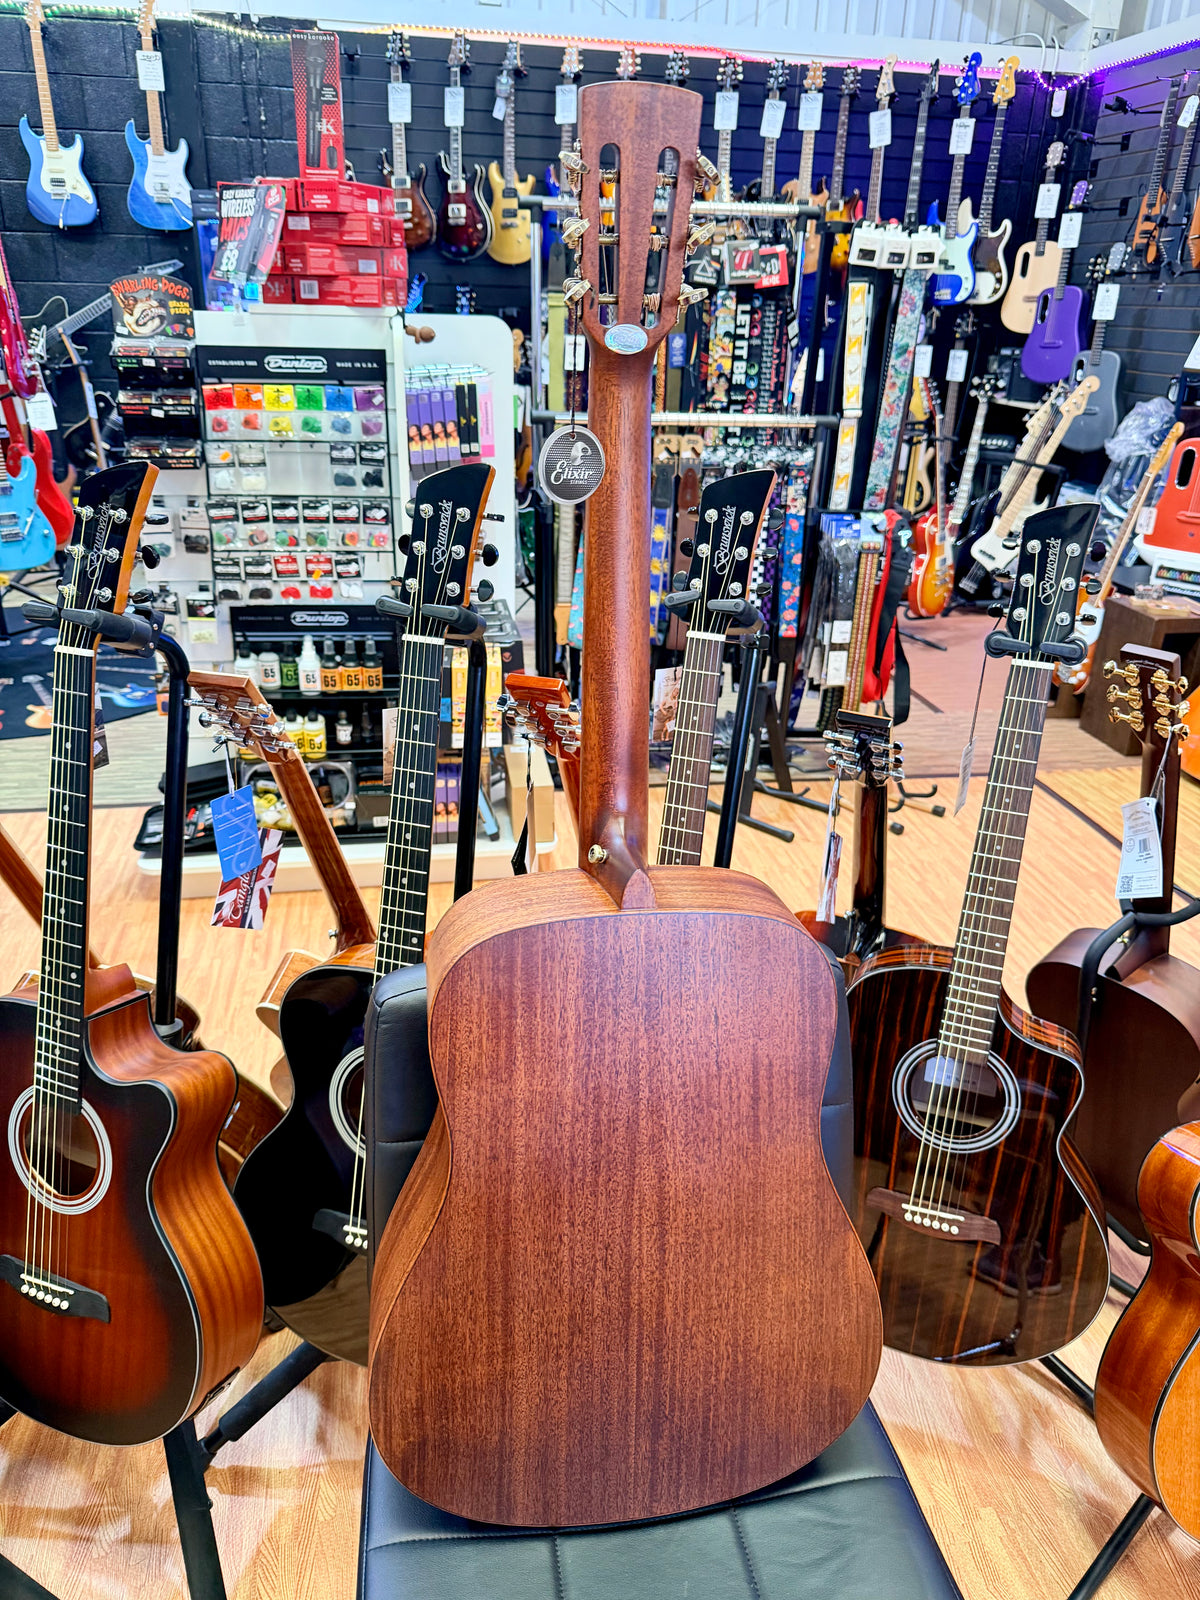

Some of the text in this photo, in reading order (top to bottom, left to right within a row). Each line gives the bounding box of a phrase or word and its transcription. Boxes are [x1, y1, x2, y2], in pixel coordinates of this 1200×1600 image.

[221, 198, 256, 218] WIRELESS
[220, 216, 251, 242] MICS
[110, 277, 159, 296] SNARLING
[735, 304, 751, 338] LET
[733, 340, 749, 359] IT
[268, 358, 326, 371] Dunlop
[731, 361, 747, 385] BE
[550, 460, 595, 485] Elixir
[86, 501, 111, 580] Brunswick
[430, 499, 453, 574] Brunswick
[713, 504, 737, 575] Brunswick
[1037, 537, 1062, 606] Brunswick
[295, 613, 347, 624] Dunlop
[263, 667, 276, 679] 65
[305, 674, 317, 684] 65
[323, 675, 337, 687] 65
[346, 675, 360, 687] 65
[367, 675, 381, 688] 65
